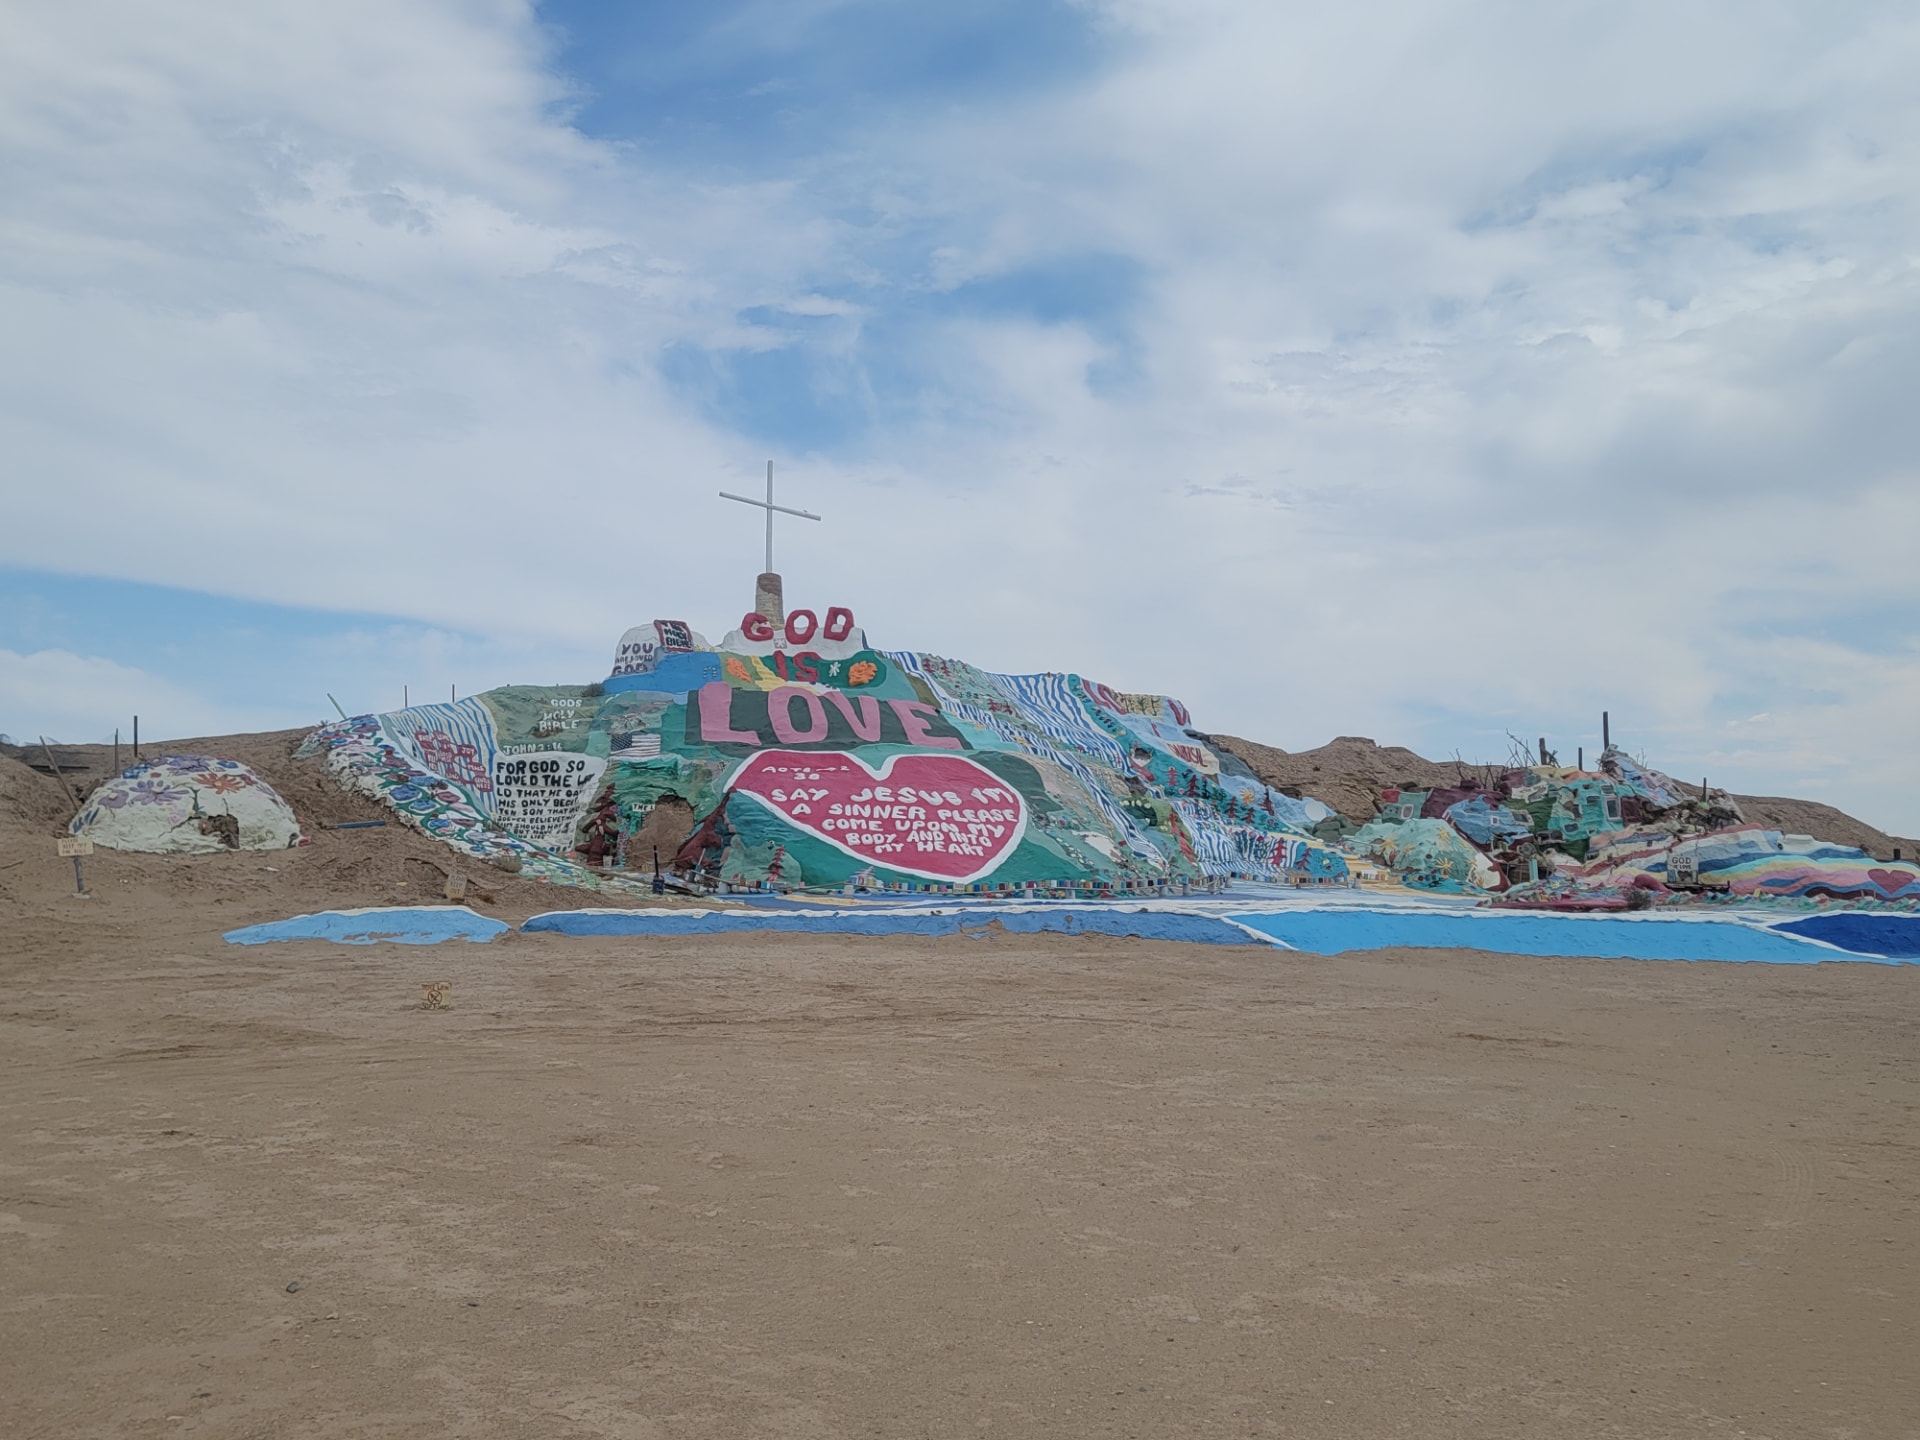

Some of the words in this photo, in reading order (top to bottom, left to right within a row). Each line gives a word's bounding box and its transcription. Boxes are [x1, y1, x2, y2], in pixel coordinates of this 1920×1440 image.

[741, 607, 854, 645] GOD
[622, 643, 653, 655] YOU
[612, 663, 648, 676] GOD
[774, 650, 821, 682] IS
[551, 699, 582, 707] GODS
[543, 710, 575, 720] HOLY
[698, 681, 963, 750] LOVE
[539, 720, 579, 732] BIBLE
[461, 747, 475, 755] JOY
[503, 744, 536, 755] JOHN
[497, 760, 526, 775] FOR
[529, 760, 560, 773] GOD
[566, 760, 585, 773] SO
[496, 774, 538, 786] LOVED
[542, 774, 573, 787] THE
[497, 788, 512, 797] LD
[516, 789, 547, 798] THAT
[771, 788, 829, 801] SAY
[850, 787, 962, 805] JESUS
[498, 800, 517, 808] HIS
[521, 799, 550, 808] ONLY
[498, 808, 516, 816] TEN
[522, 808, 543, 816] SON
[792, 803, 811, 815] A
[828, 803, 926, 819] SINNER
[937, 809, 1018, 823] PLEASE
[821, 819, 883, 831] COME
[895, 821, 960, 834] UPON
[967, 823, 1005, 838] MY
[845, 833, 897, 846] BODY
[906, 831, 945, 843] AND
[949, 832, 992, 847] INTO
[875, 843, 904, 853] MY
[917, 841, 985, 857] HEART
[1672, 856, 1691, 864] GOD
